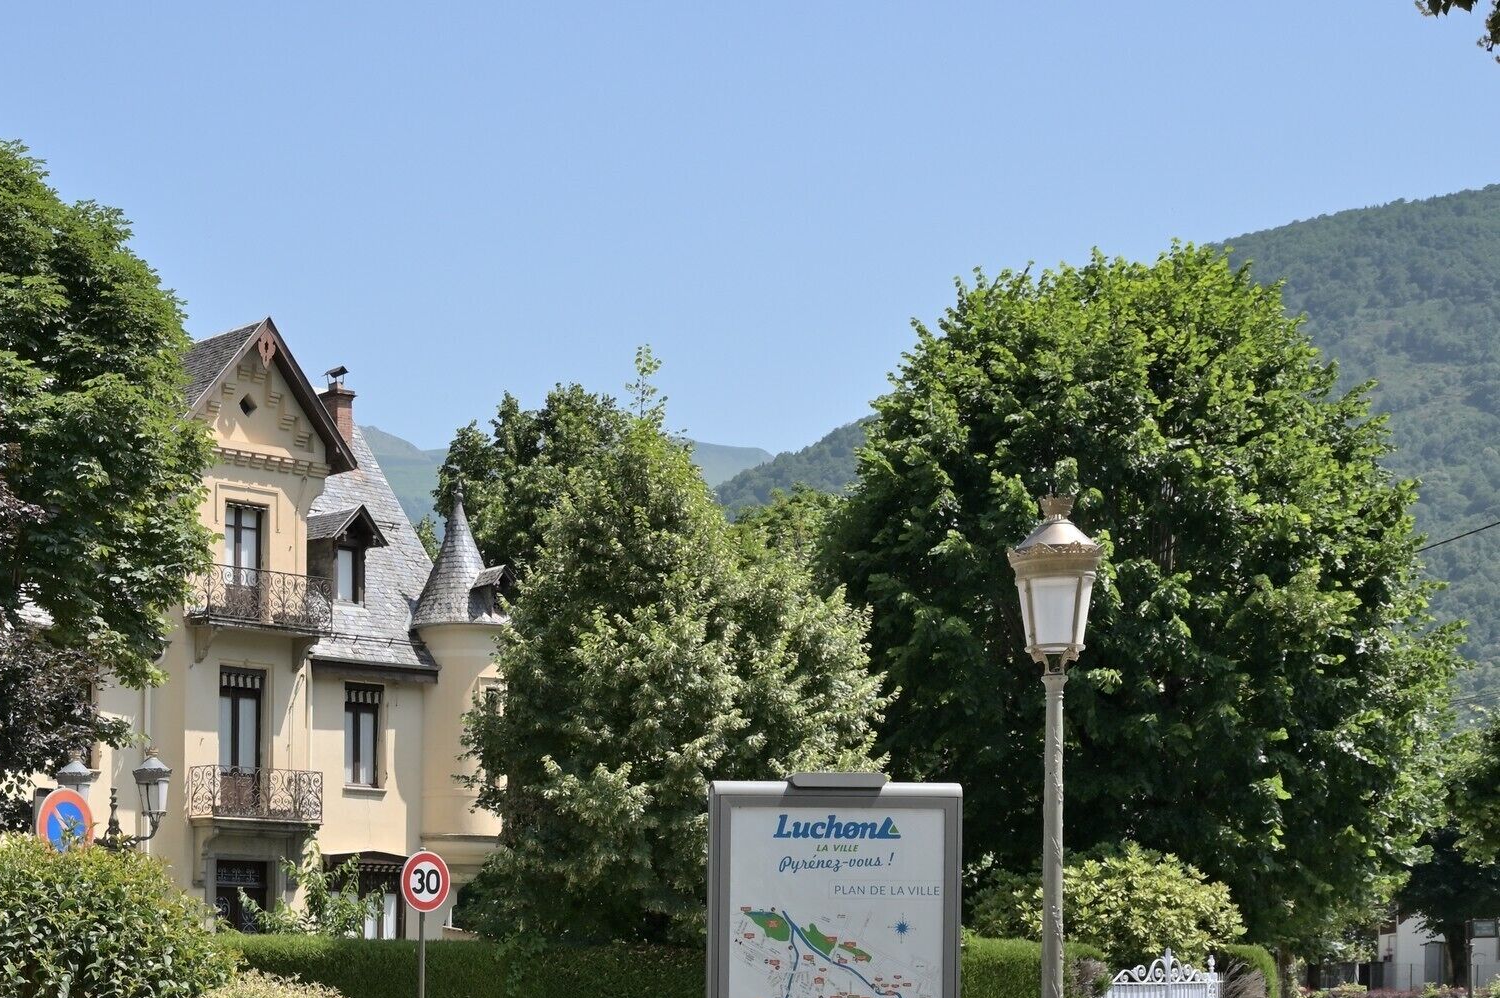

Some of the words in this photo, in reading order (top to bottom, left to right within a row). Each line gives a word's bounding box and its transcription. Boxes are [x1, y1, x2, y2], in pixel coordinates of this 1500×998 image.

[773, 814, 879, 839] Luchon
[816, 844, 829, 852] LA
[833, 844, 859, 853] VILLE
[412, 869, 440, 894] 30
[834, 885, 866, 895] PLAN
[870, 885, 886, 896] DE
[890, 886, 905, 896] LA
[908, 886, 940, 896] VILLE
